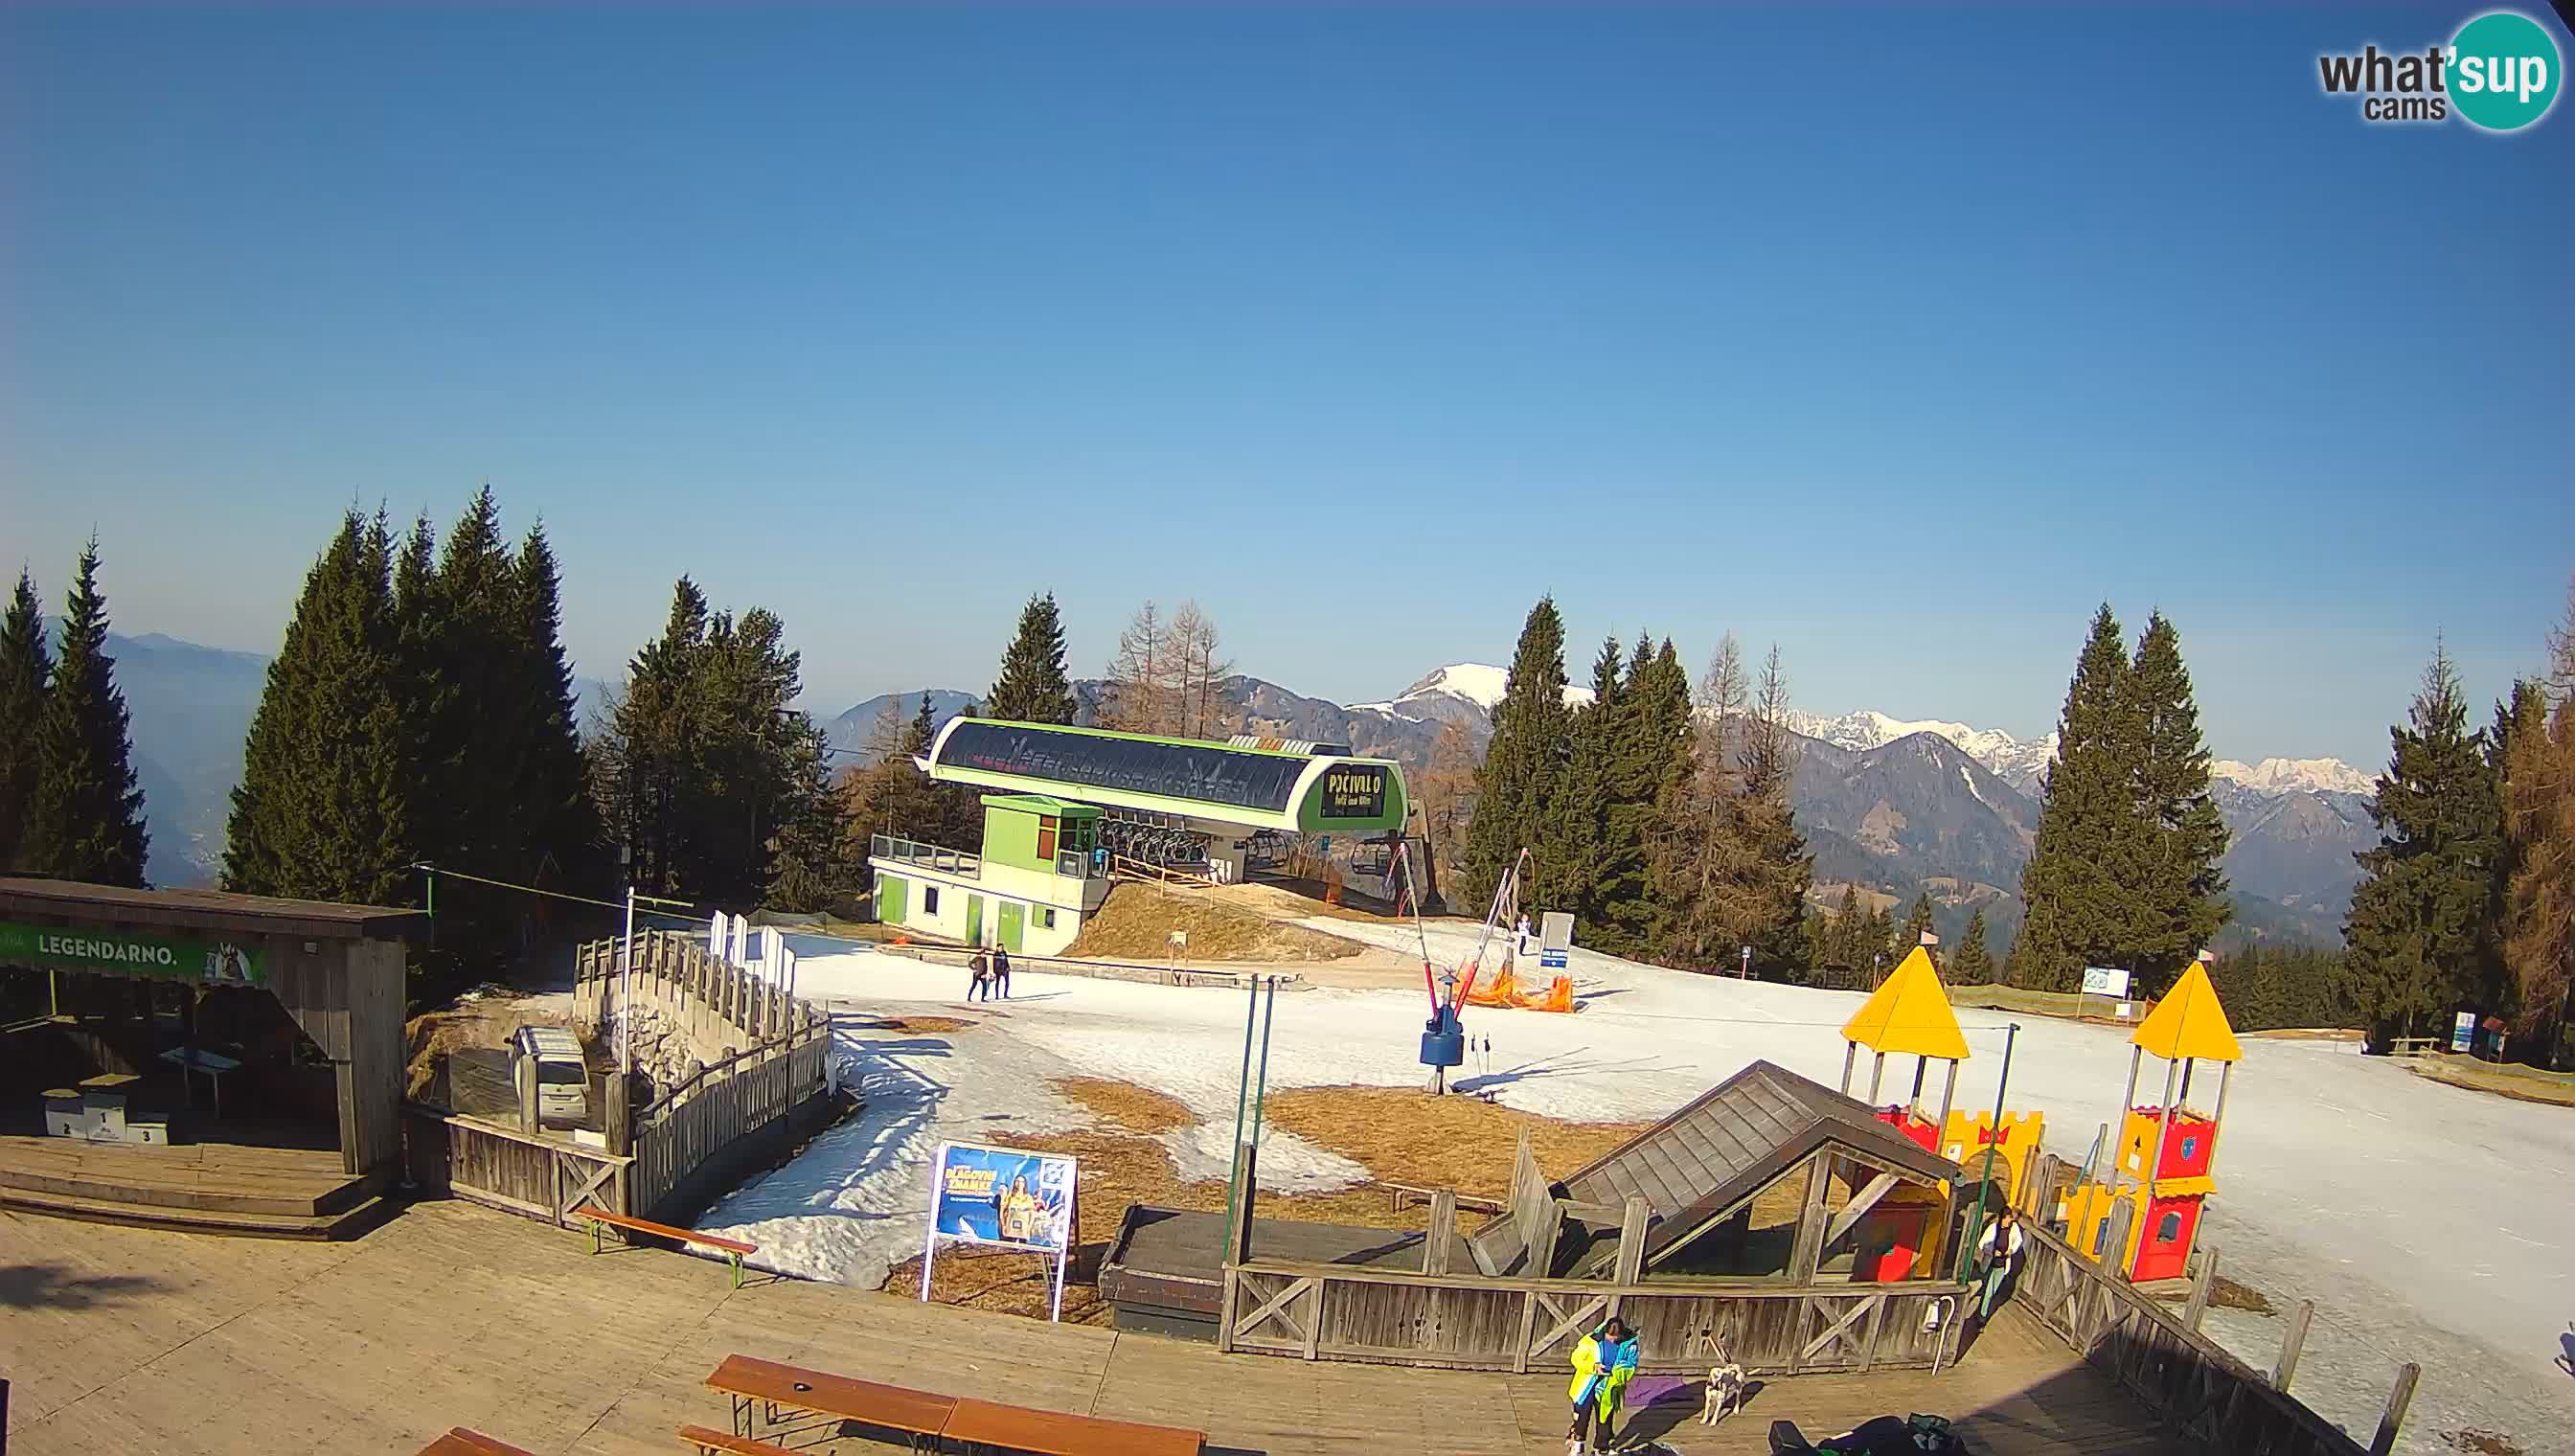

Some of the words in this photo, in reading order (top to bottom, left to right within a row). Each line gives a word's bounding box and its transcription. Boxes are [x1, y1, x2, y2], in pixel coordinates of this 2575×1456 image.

[38, 934, 178, 966] LEGENDARNO.
[100, 1111, 106, 1124] 1
[63, 1123, 71, 1135] 2
[143, 1130, 150, 1142] 3
